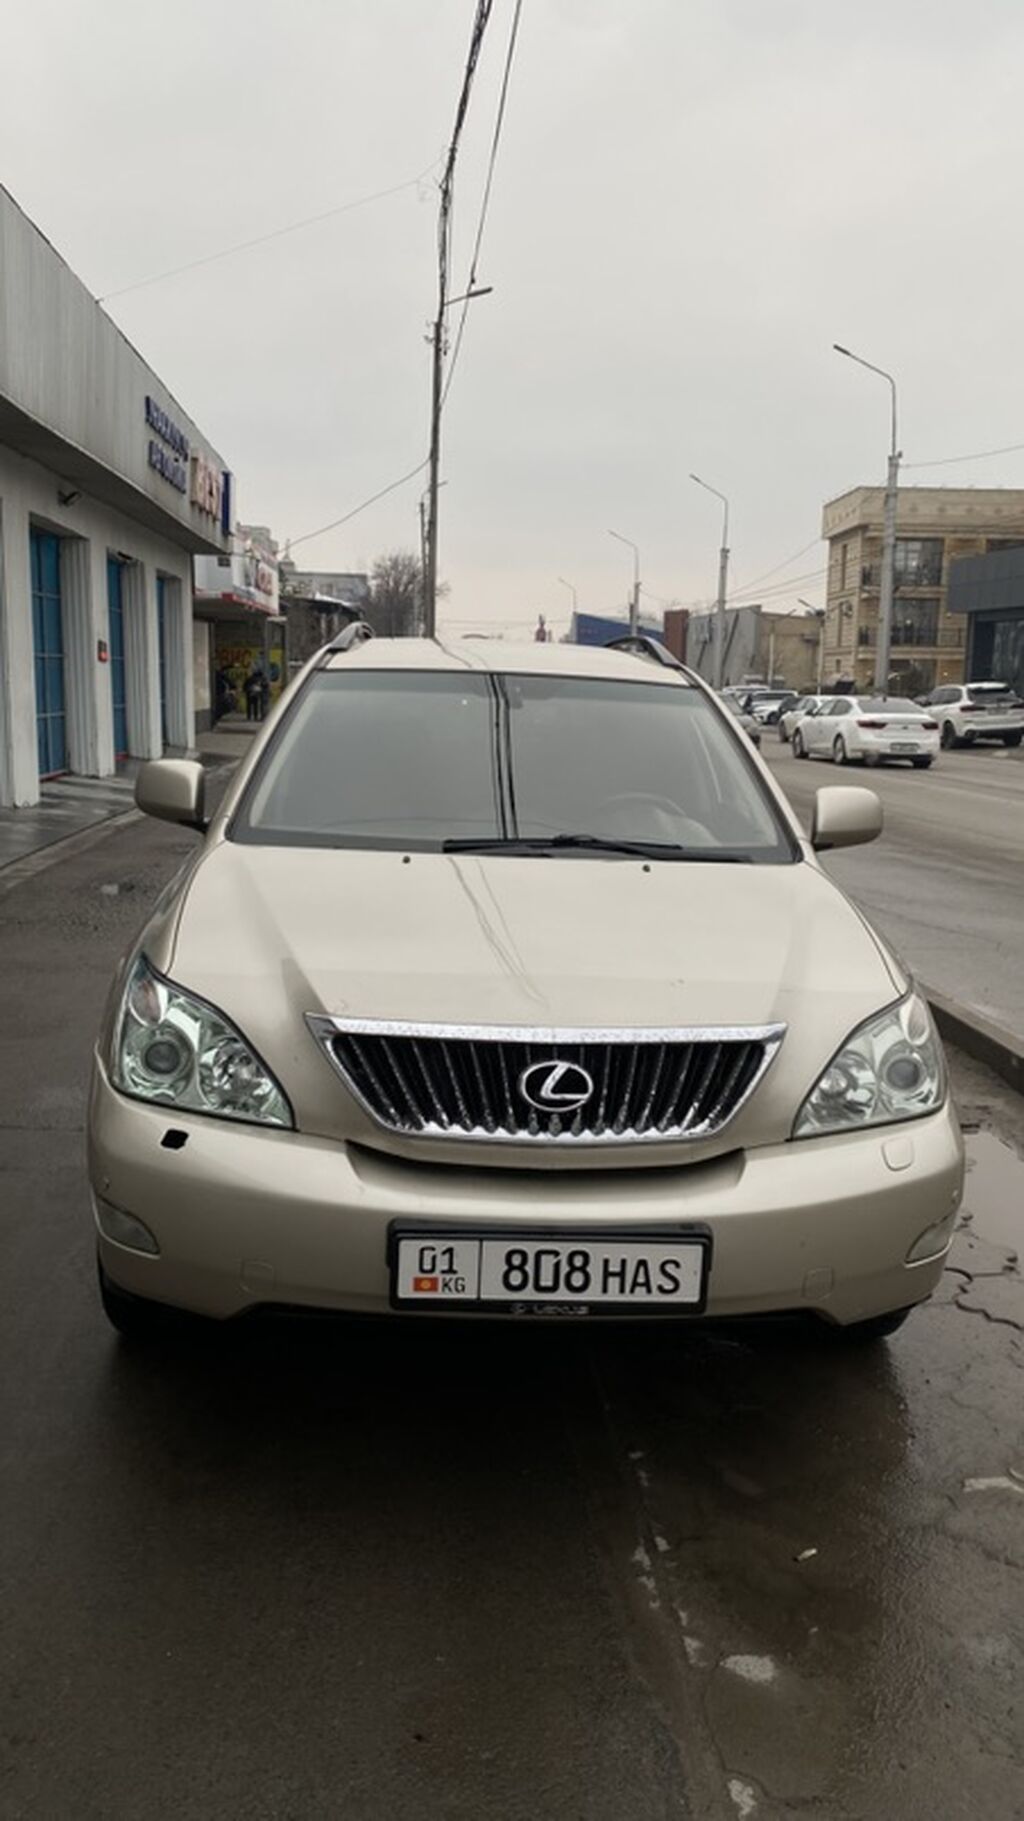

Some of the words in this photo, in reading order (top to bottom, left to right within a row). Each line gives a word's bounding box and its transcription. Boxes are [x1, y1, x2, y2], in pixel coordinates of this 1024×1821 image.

[418, 1246, 459, 1275] 01
[501, 1248, 592, 1294] 808
[600, 1257, 682, 1295] HAS
[441, 1277, 466, 1294] KG
